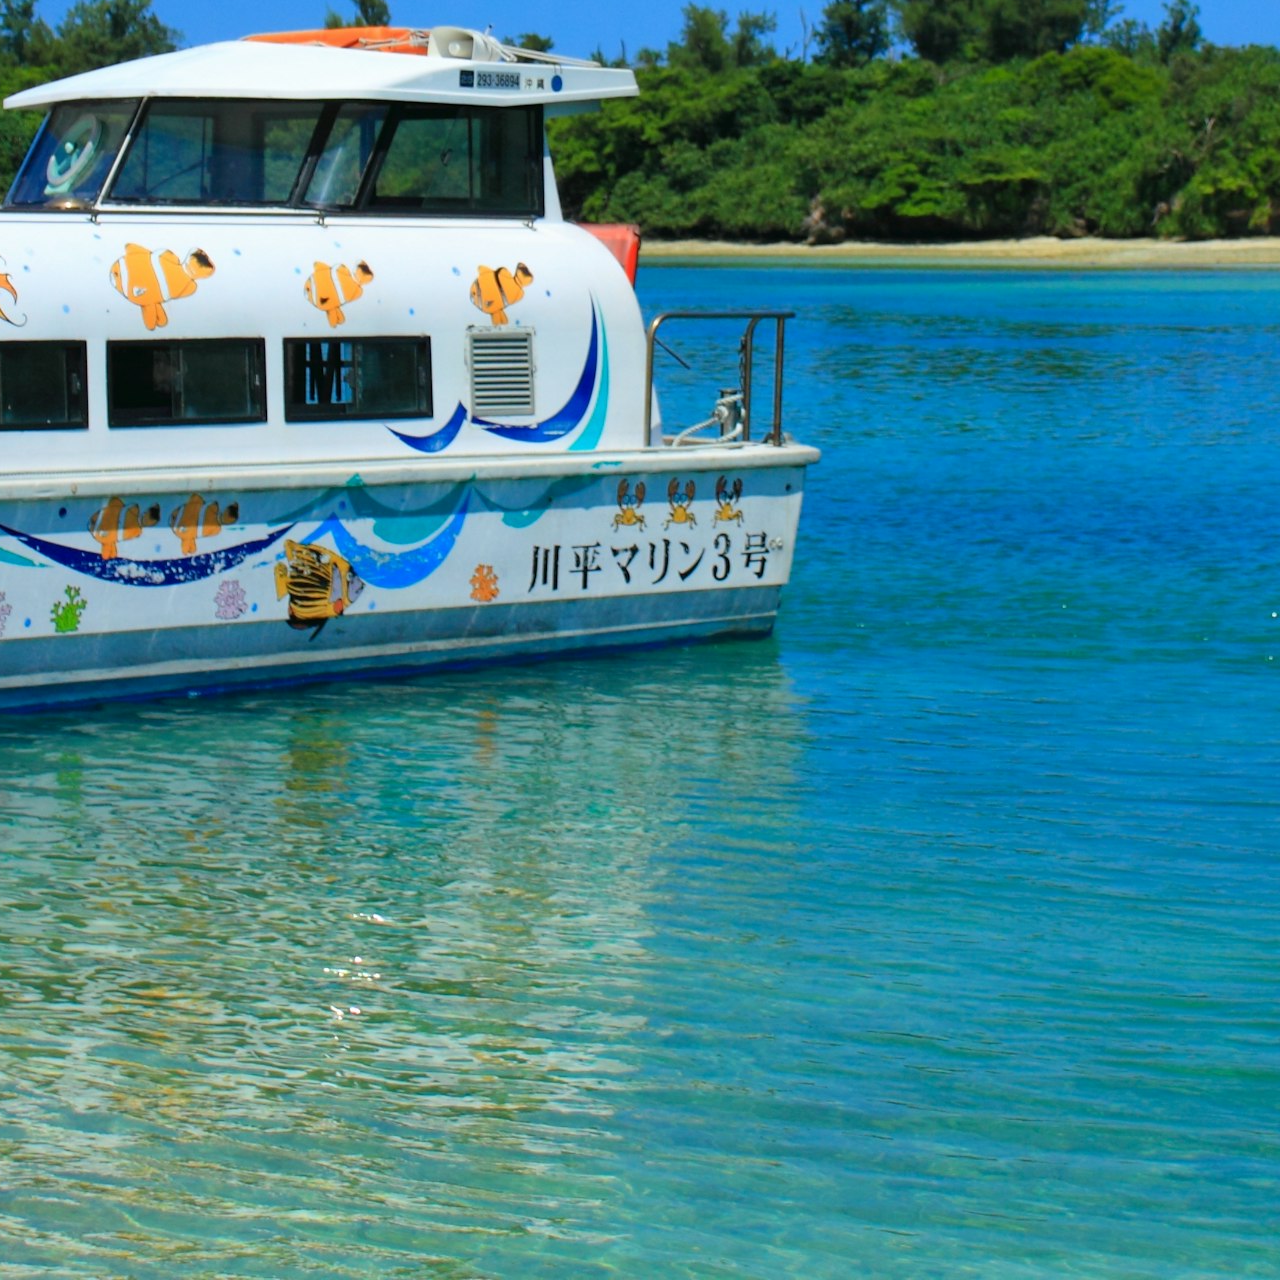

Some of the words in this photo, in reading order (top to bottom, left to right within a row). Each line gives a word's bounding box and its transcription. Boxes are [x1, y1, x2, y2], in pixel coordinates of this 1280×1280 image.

[528, 531, 770, 592] 川平マリン3号
